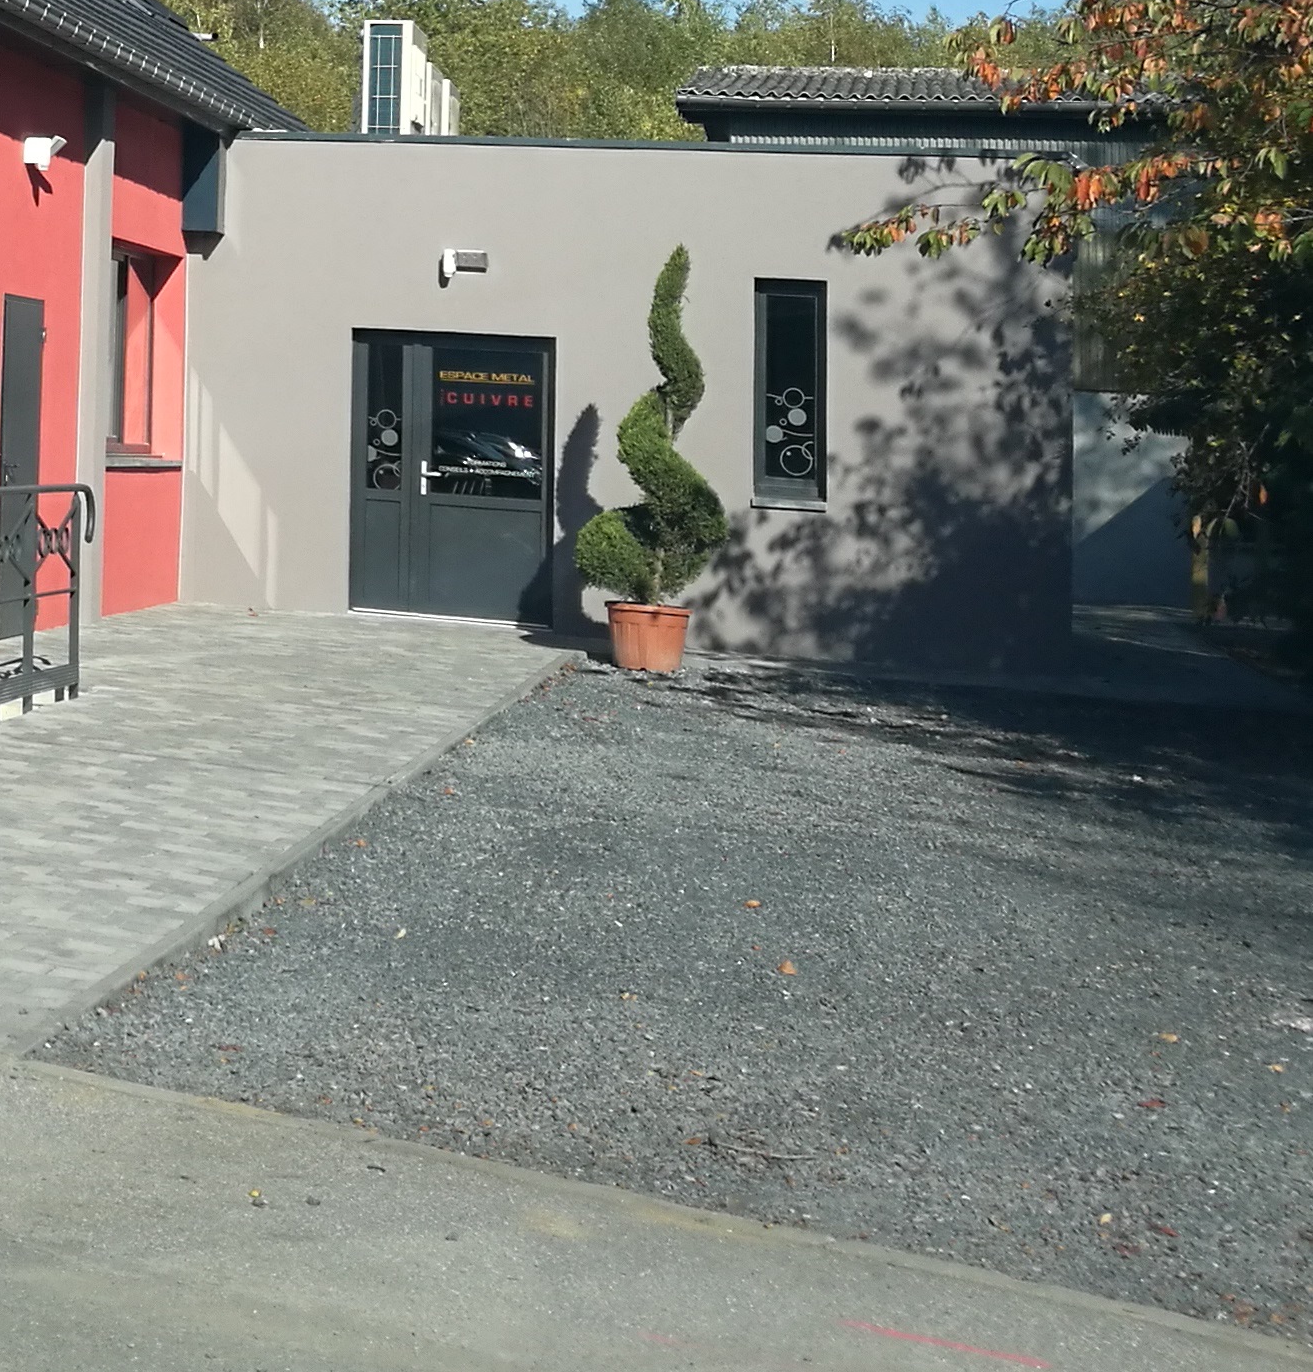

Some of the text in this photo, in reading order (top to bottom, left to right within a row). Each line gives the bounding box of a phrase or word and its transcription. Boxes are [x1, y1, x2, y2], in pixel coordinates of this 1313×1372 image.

[439, 370, 533, 382] ESPACE METAL
[446, 391, 533, 407] CUIVRE
